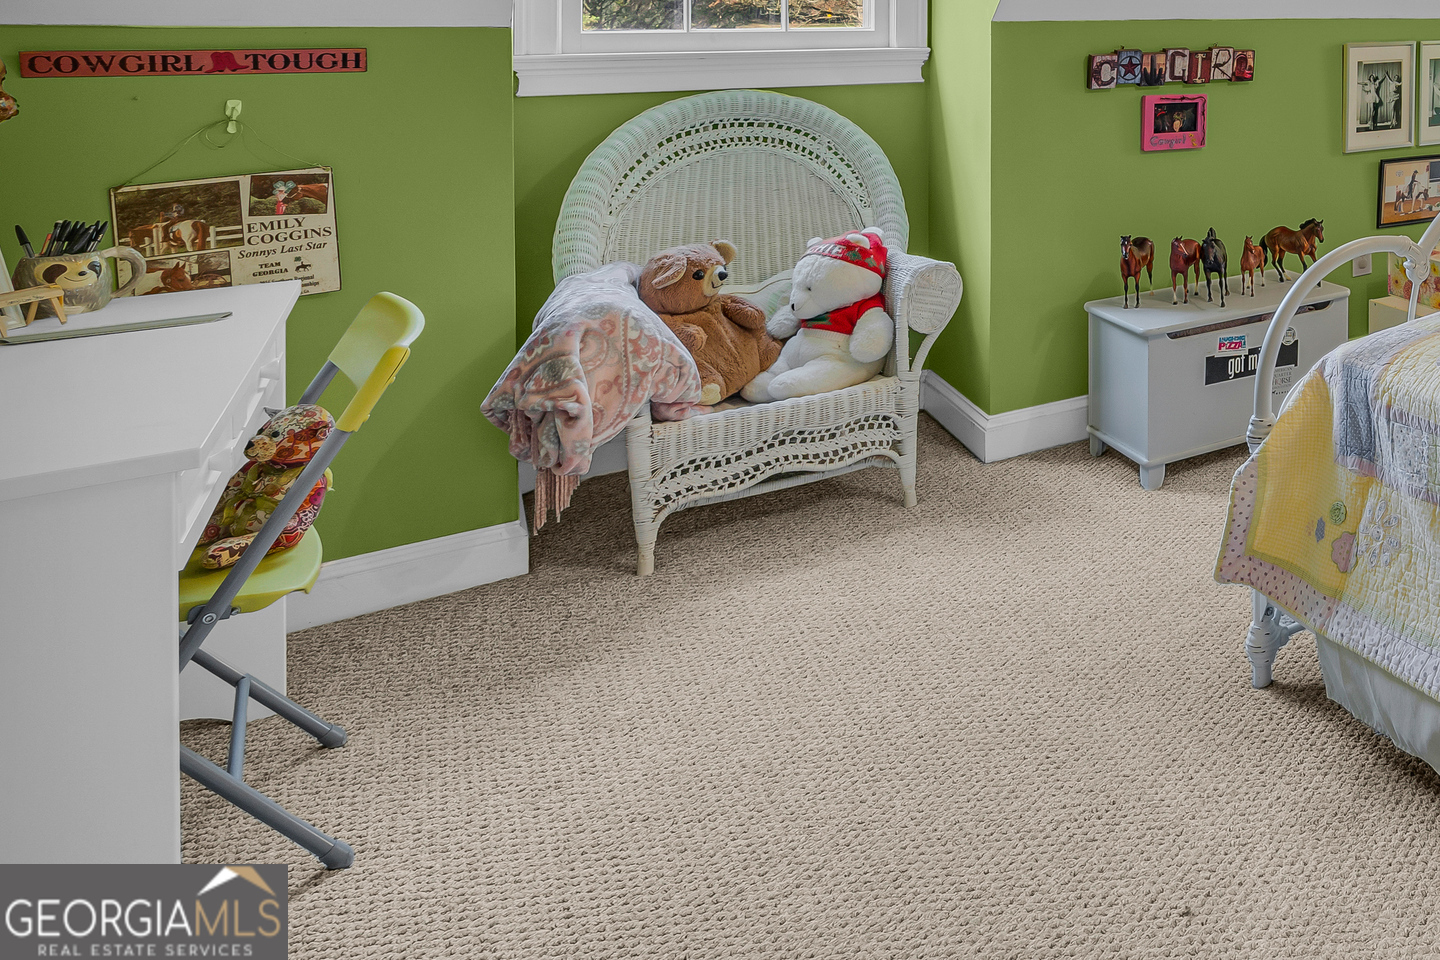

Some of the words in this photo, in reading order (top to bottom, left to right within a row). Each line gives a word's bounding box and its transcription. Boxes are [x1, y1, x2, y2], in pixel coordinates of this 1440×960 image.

[28, 54, 206, 74] COWGIRL
[244, 52, 362, 71] TOUGH
[1150, 134, 1186, 148] Cowgirl
[247, 217, 305, 233] EMILY
[247, 226, 332, 246] COGGINS
[238, 248, 277, 259] Sonnys
[280, 245, 303, 254] Last
[305, 241, 328, 251] Star
[252, 268, 289, 277] GEORGIA
[258, 261, 281, 269] TEAM
[1228, 354, 1246, 379] got
